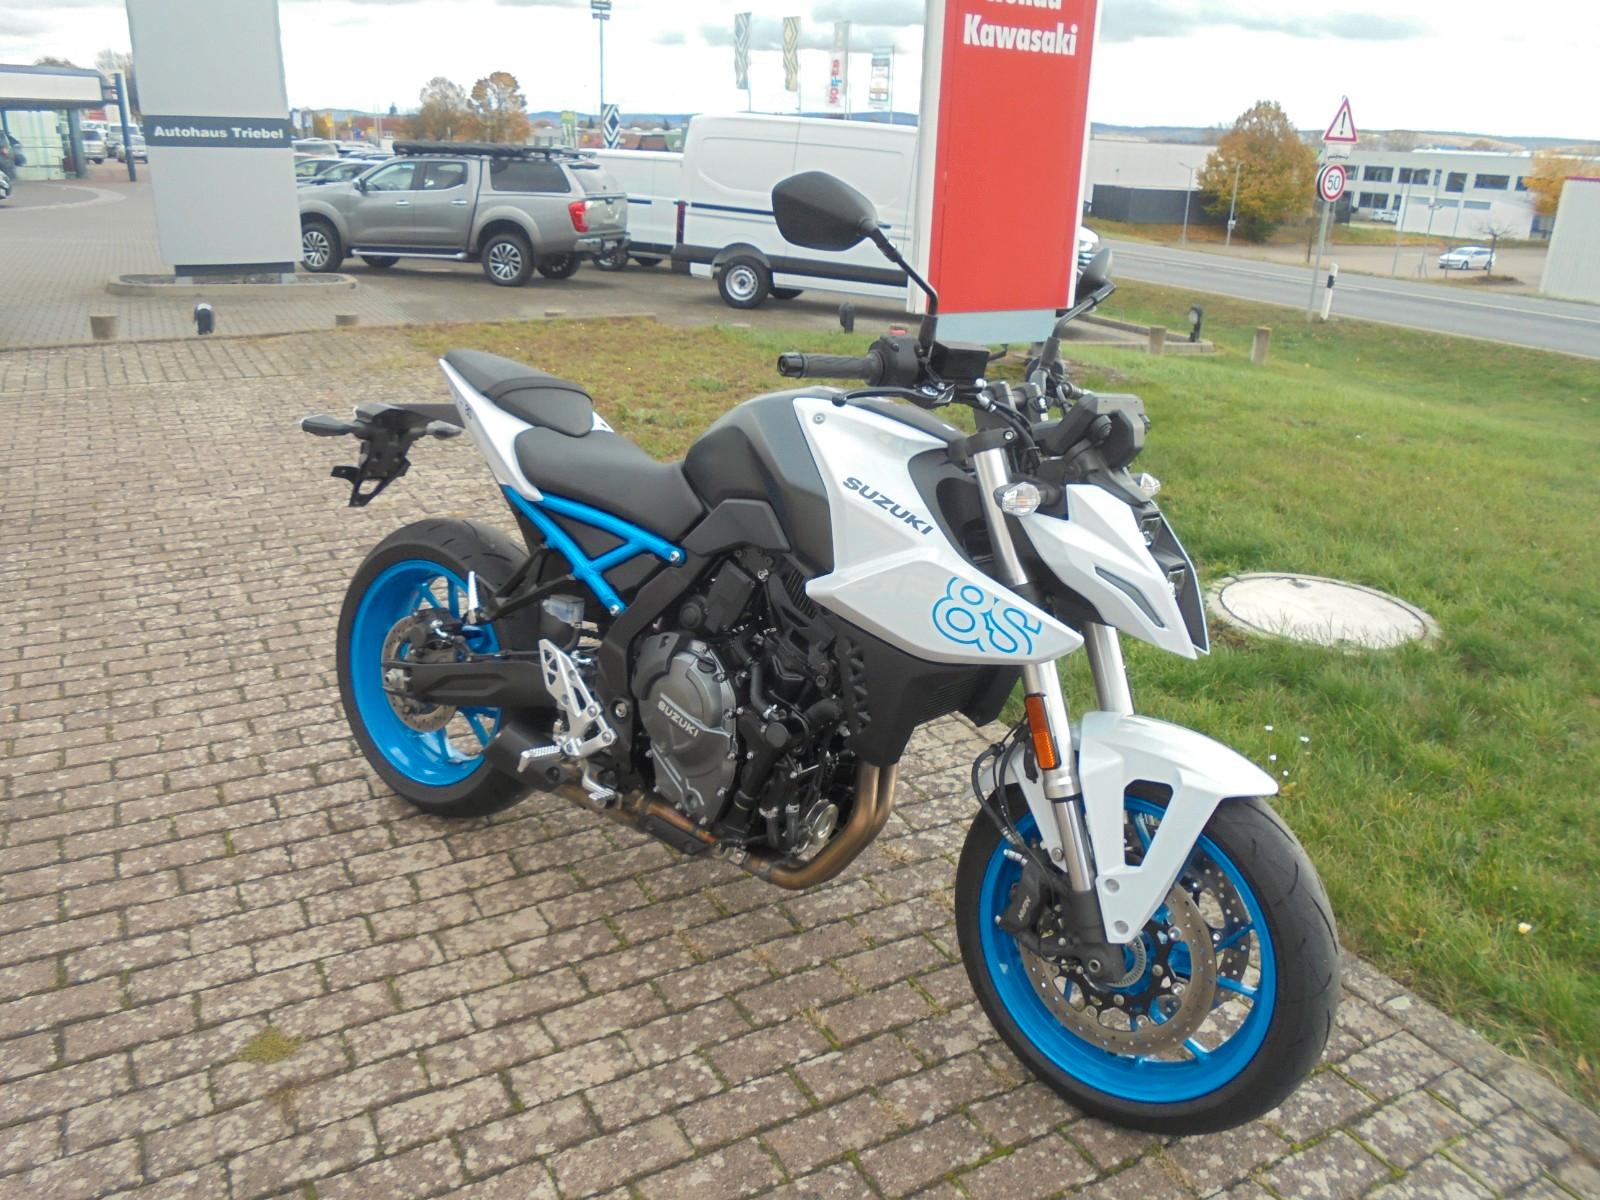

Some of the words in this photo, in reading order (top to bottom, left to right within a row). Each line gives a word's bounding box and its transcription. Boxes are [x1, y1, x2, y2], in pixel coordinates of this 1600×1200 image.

[963, 13, 1078, 56] Kawasaki
[154, 125, 228, 139] Autohaus
[231, 126, 284, 140] Triebel
[1327, 175, 1341, 191] 50
[842, 476, 934, 535] SUZUKI
[657, 701, 700, 739] SUZUKI
